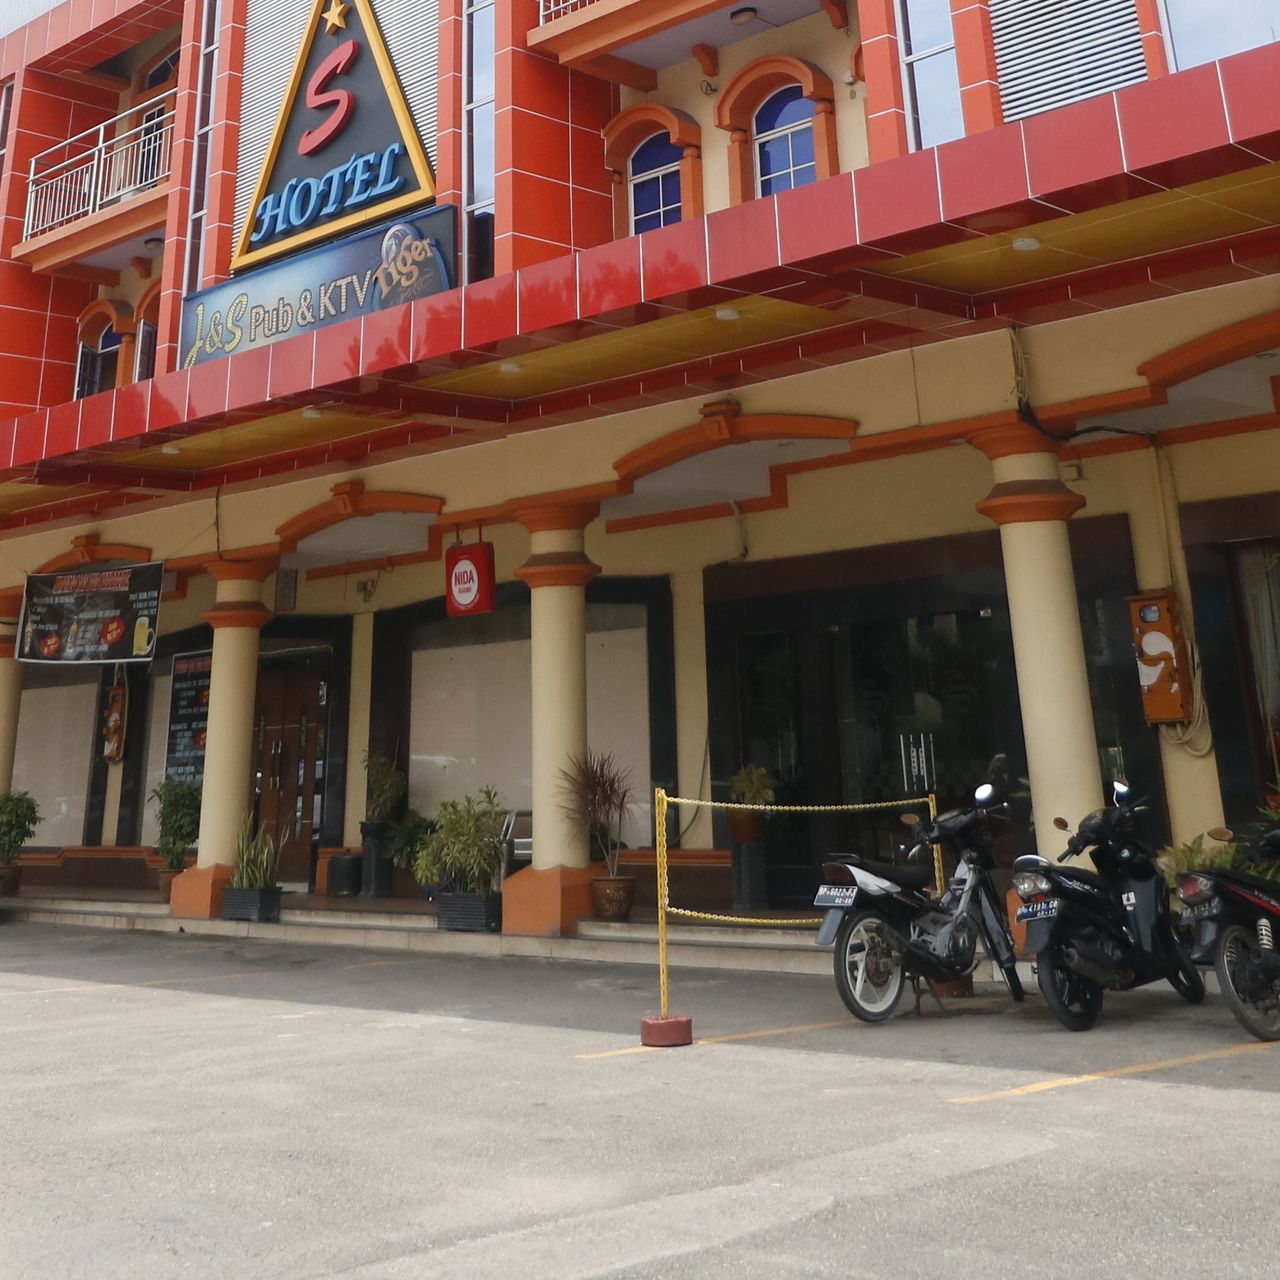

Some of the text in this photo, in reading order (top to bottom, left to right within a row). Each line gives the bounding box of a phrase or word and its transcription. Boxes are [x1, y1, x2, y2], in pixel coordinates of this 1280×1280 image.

[296, 38, 360, 157] S
[250, 142, 406, 243] HOTEL
[373, 234, 434, 299] Tiger
[184, 270, 372, 370] J&S Pub & KTV
[454, 569, 475, 587] NIDA
